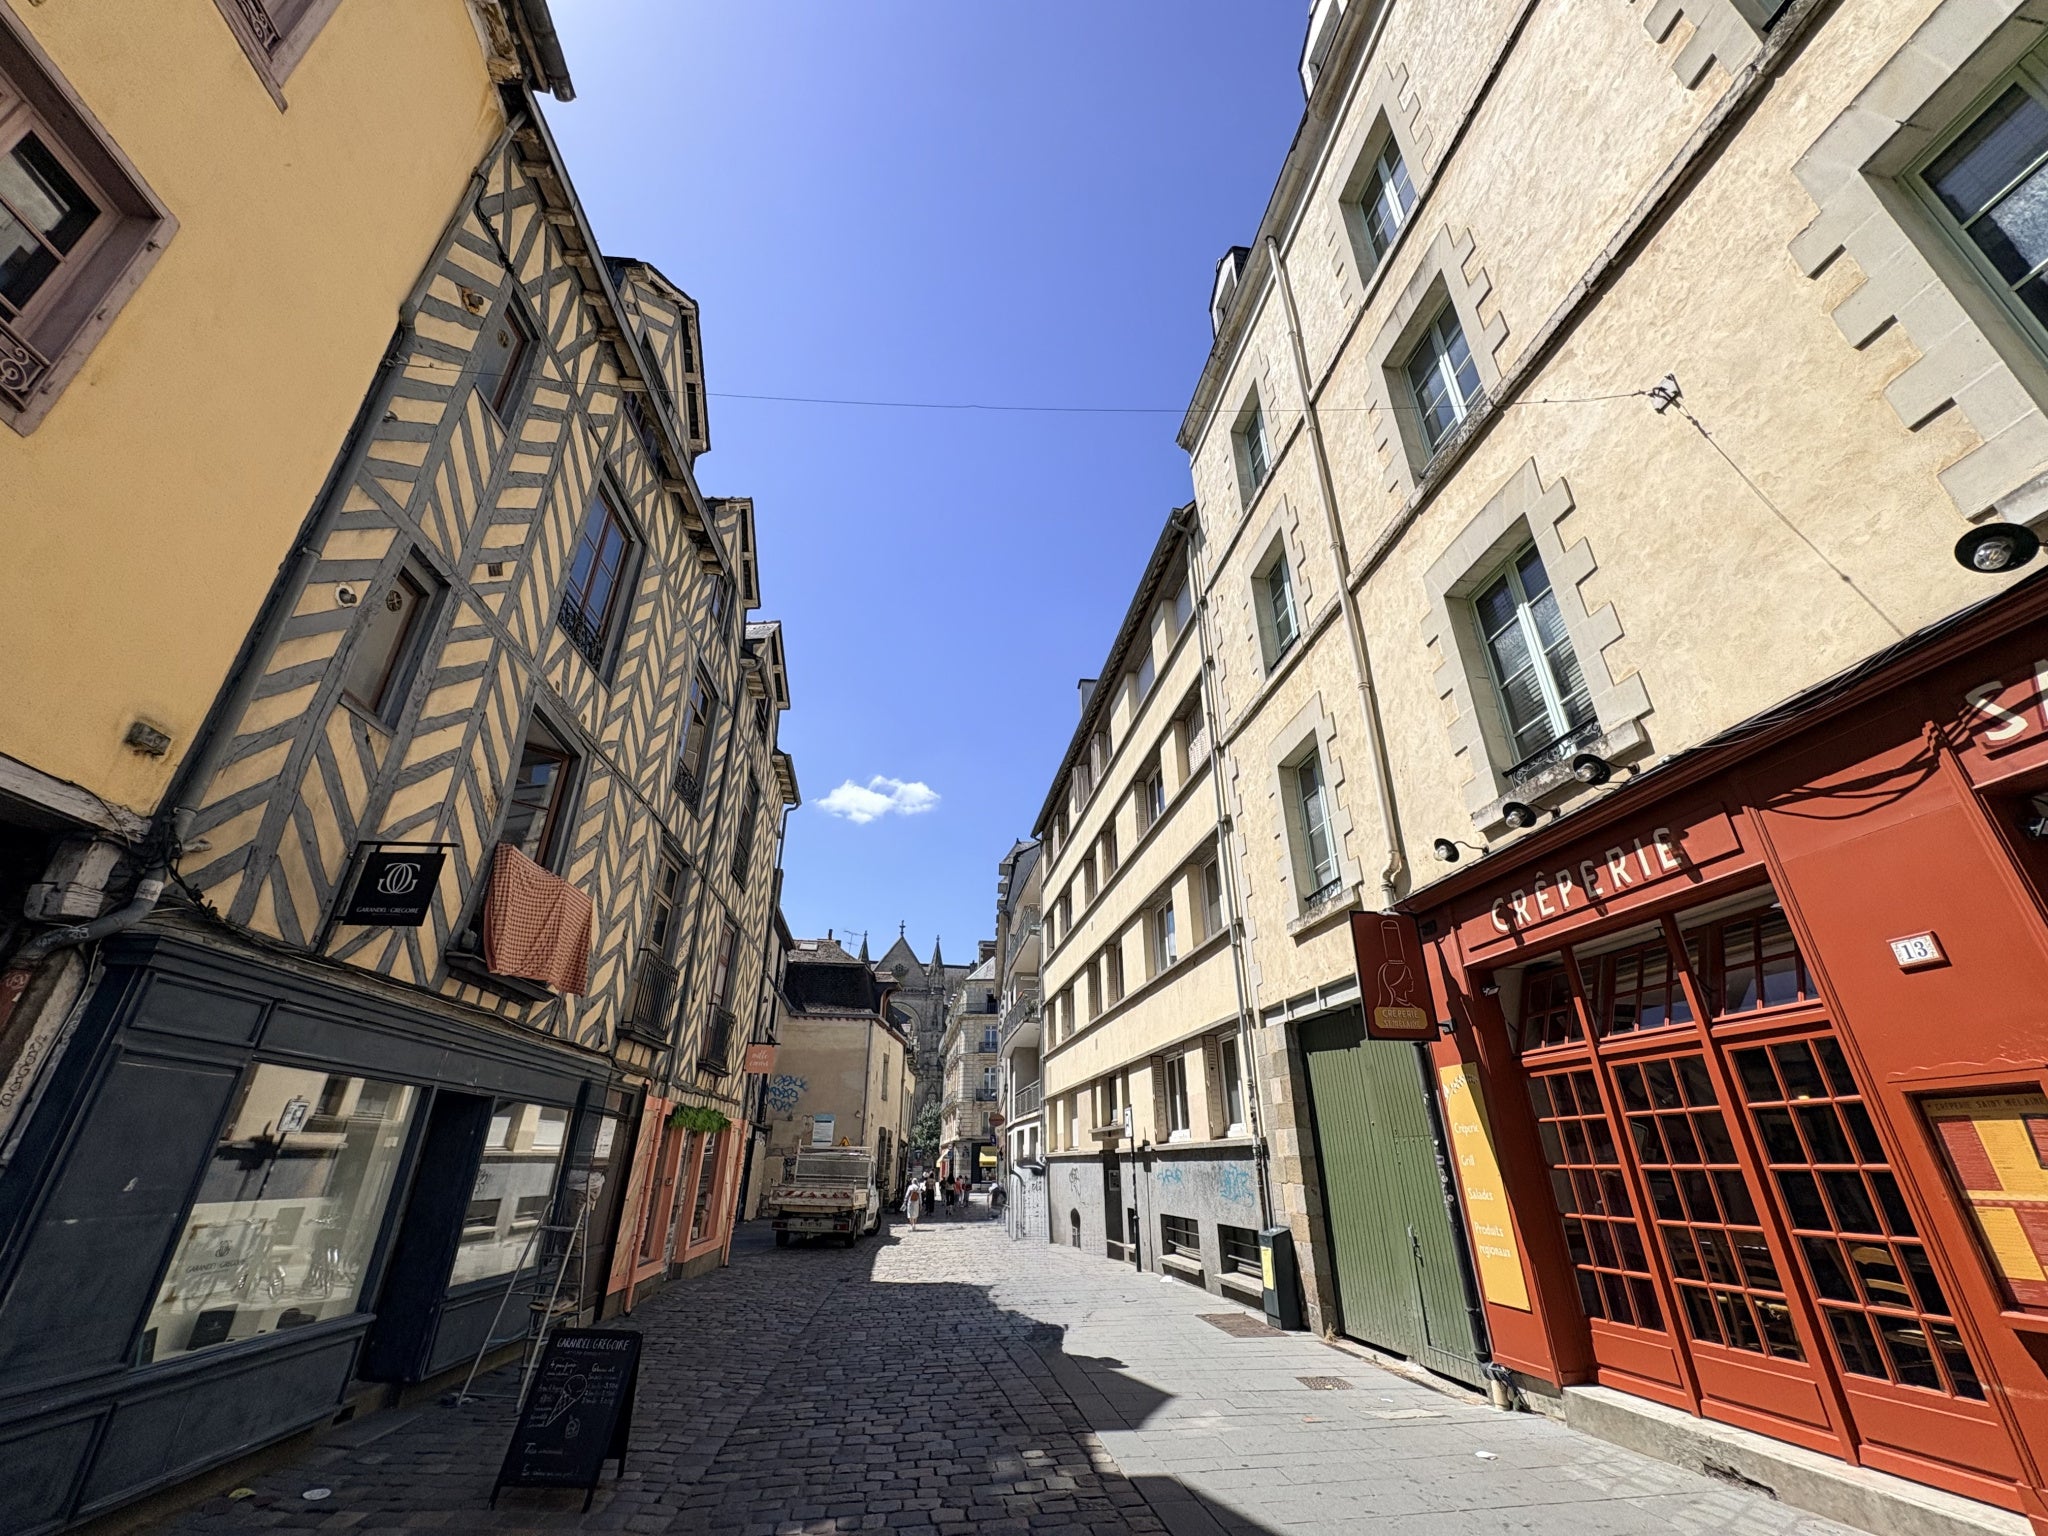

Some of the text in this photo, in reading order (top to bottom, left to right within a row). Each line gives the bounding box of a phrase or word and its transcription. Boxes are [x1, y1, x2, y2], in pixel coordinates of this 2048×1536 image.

[1491, 827, 1683, 932] CRÊPERIE
[1901, 941, 1928, 960] 13
[1976, 1100, 2000, 1109] SAINT
[1461, 1154, 1475, 1166] Grill
[1467, 1187, 1494, 1201] Salades
[1474, 1221, 1504, 1238] Produits
